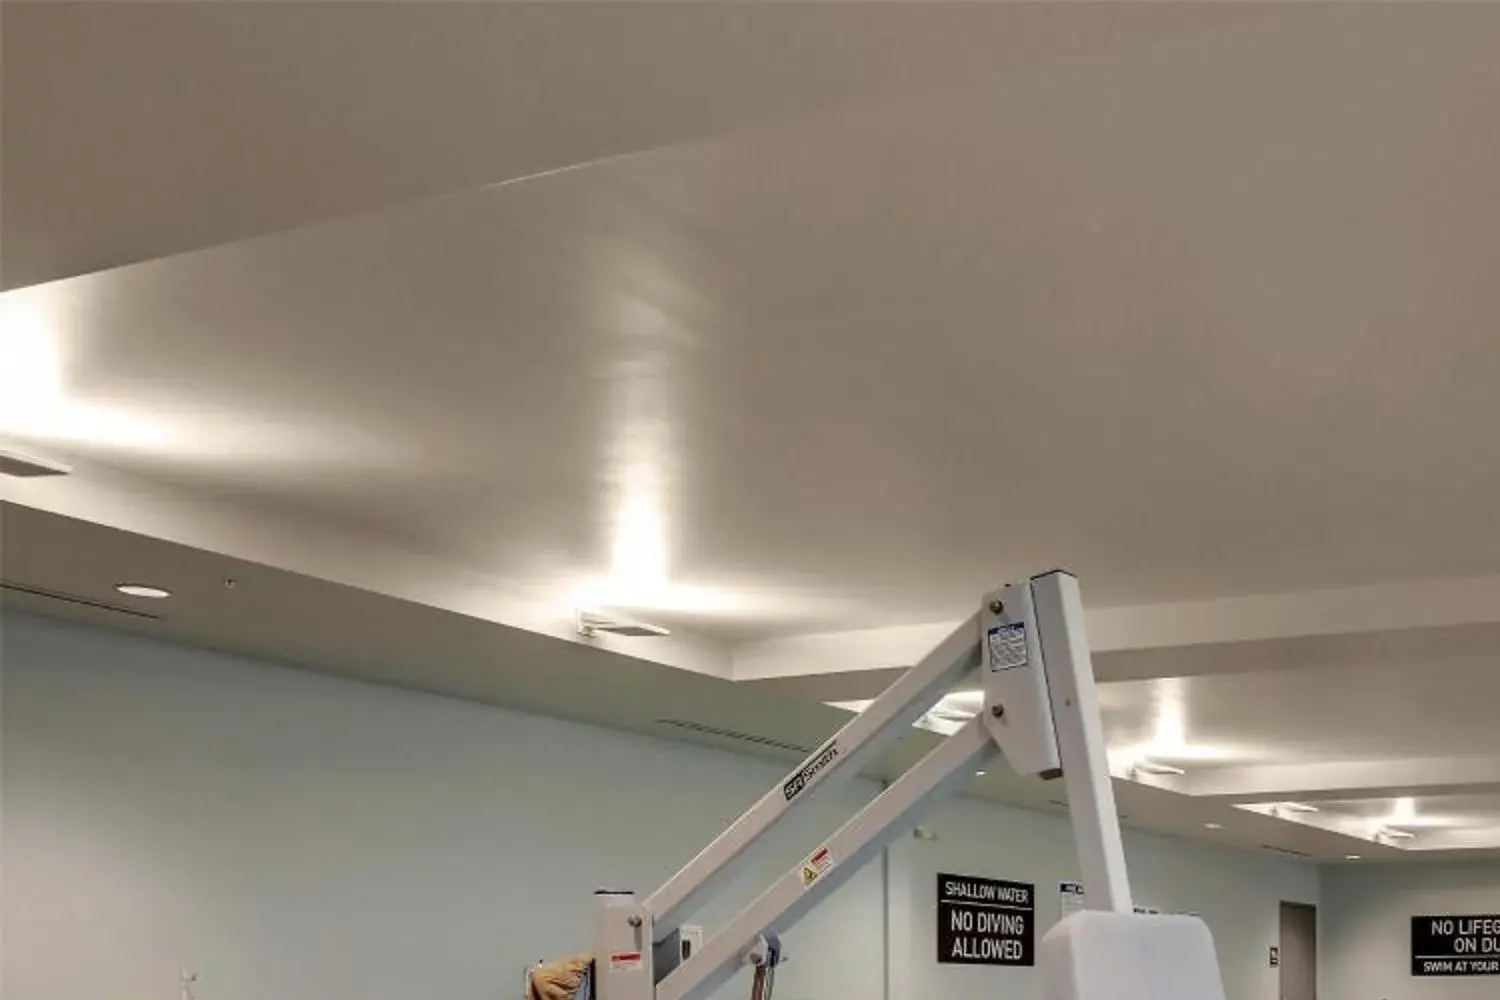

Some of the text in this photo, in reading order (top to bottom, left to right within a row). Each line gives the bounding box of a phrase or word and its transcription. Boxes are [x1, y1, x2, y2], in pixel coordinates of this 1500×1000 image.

[945, 881, 1029, 904] SHALLOW WATER
[951, 910, 1024, 935] NO DIVING
[1431, 920, 1454, 935] NO
[951, 936, 1023, 960] ALLOWED
[1453, 938, 1477, 952] ON
[1423, 960, 1453, 972] SWIM
[1455, 961, 1468, 972] AT
[1470, 960, 1499, 972] YOUR
